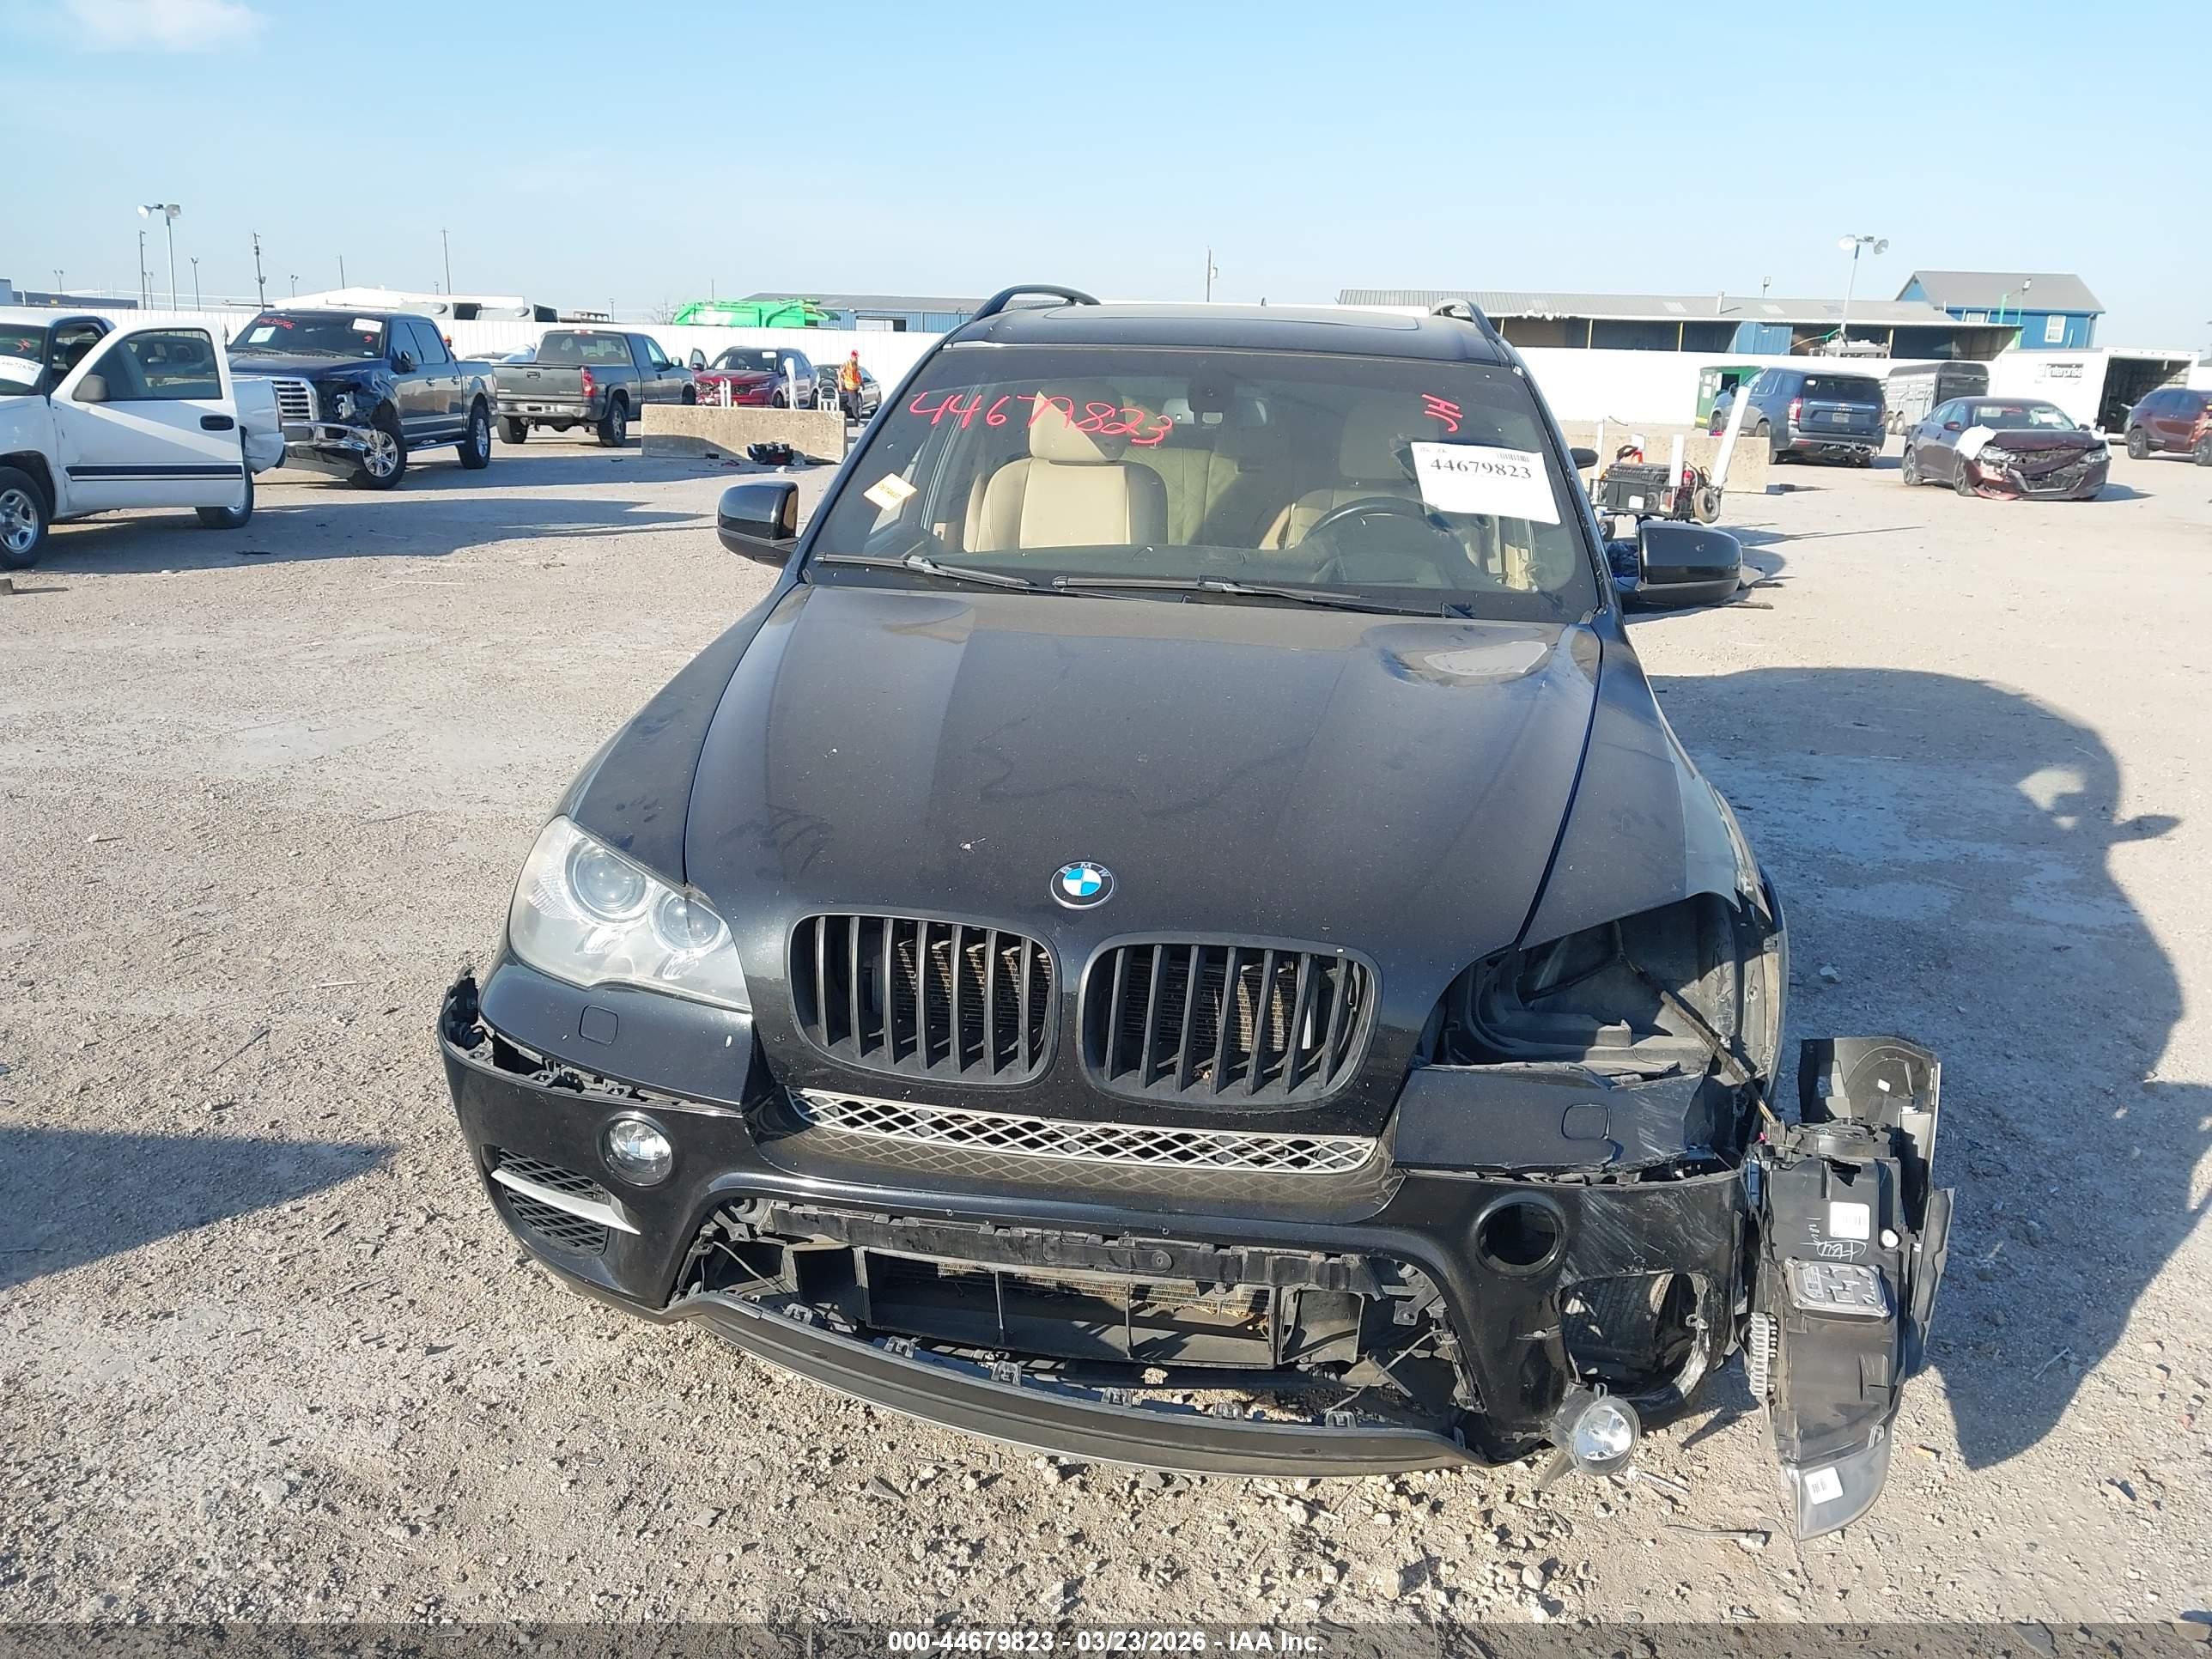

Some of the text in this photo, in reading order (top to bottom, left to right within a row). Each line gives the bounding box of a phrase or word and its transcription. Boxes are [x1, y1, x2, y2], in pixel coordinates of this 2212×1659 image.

[909, 392, 1174, 445] 44679823
[1430, 459, 1532, 479] 44679823
[1059, 862, 1111, 878] BMW
